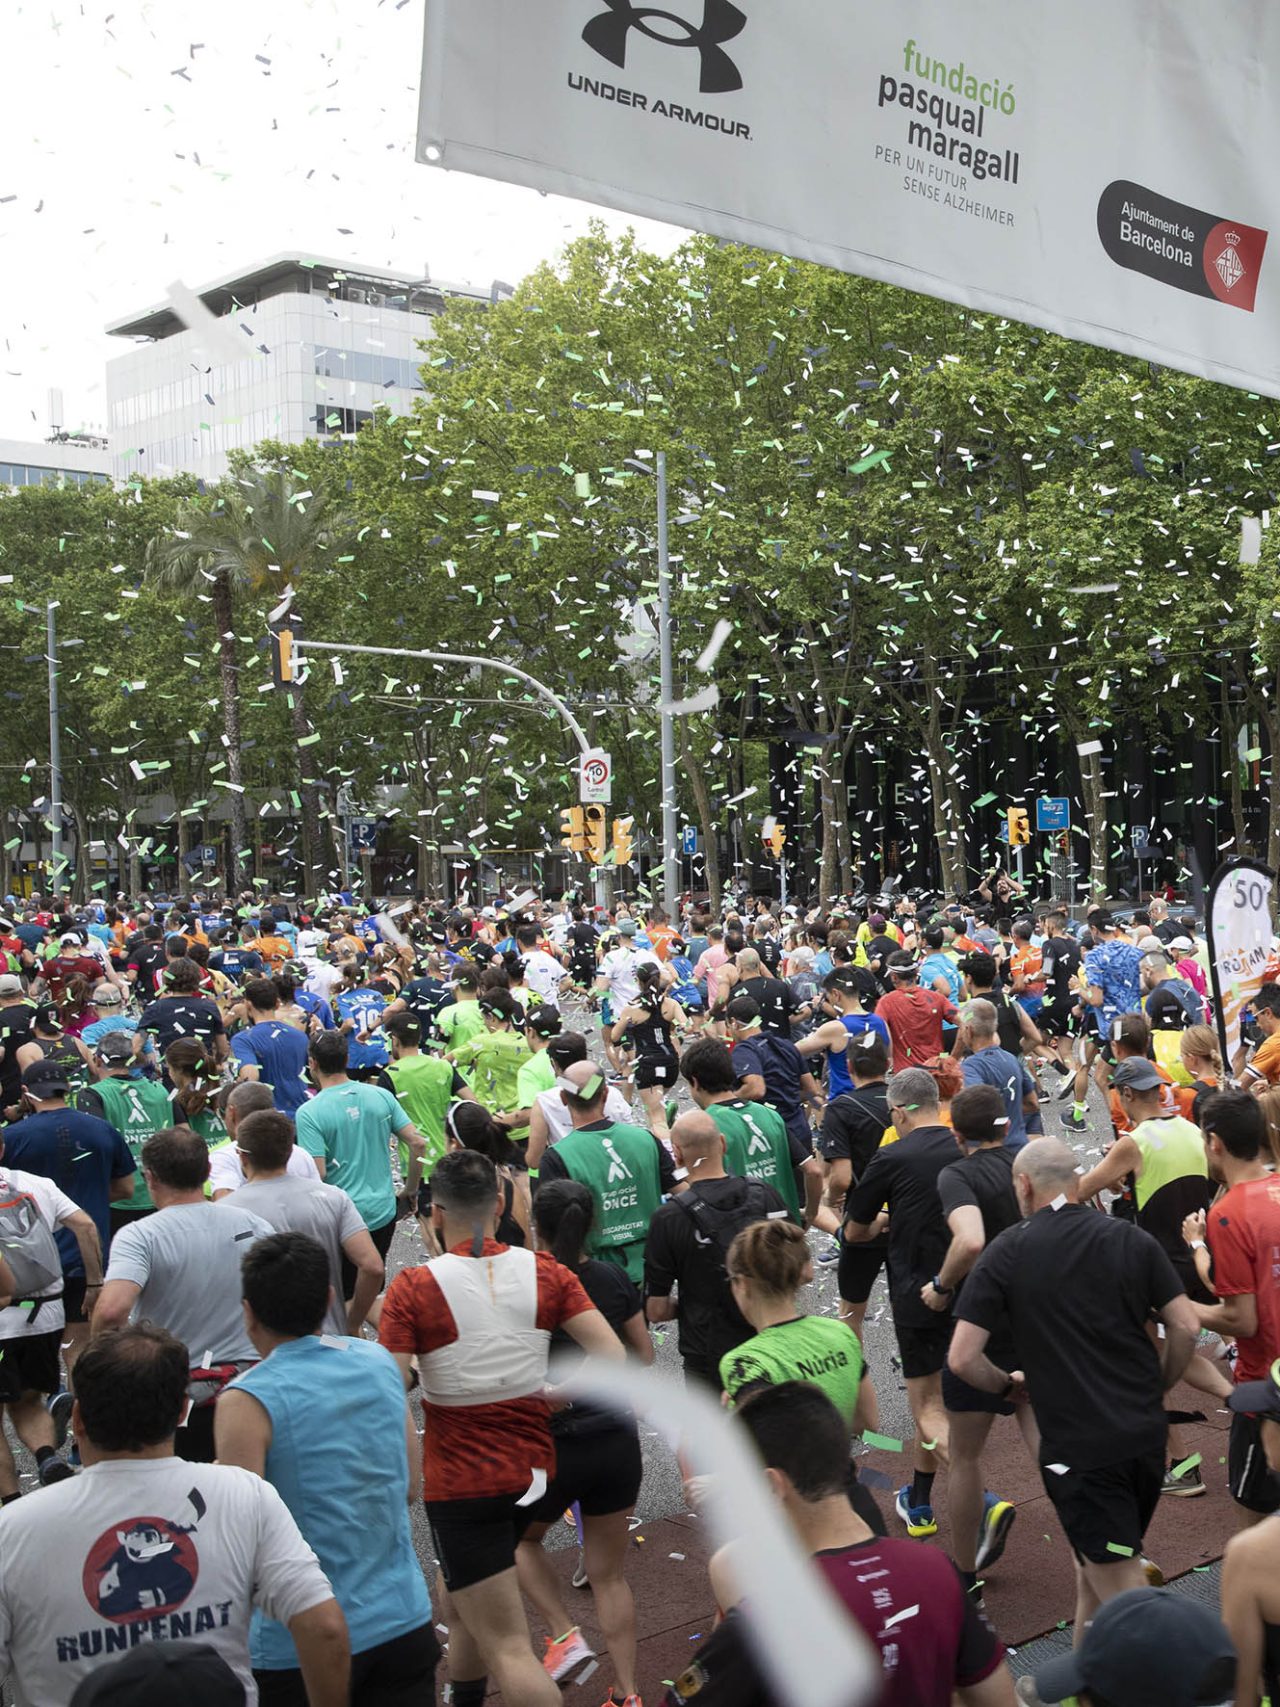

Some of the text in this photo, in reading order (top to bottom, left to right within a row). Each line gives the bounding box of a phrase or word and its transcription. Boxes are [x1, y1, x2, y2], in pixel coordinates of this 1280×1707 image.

[904, 39, 1015, 115] fundació
[568, 72, 751, 140] UNDER ARMOUR
[878, 74, 984, 138] pasqual
[875, 145, 967, 191] PER UN FUTUR
[908, 120, 1019, 184] maragall
[904, 176, 1014, 227] SENSE ALZHEIMER
[1121, 201, 1195, 242] Ajuntament de
[1120, 220, 1192, 267] Barcelona
[686, 829, 694, 843] P
[603, 1194, 638, 1211] ONCE
[796, 1350, 848, 1379] Núria
[56, 1600, 232, 1662] RUNPENAT
